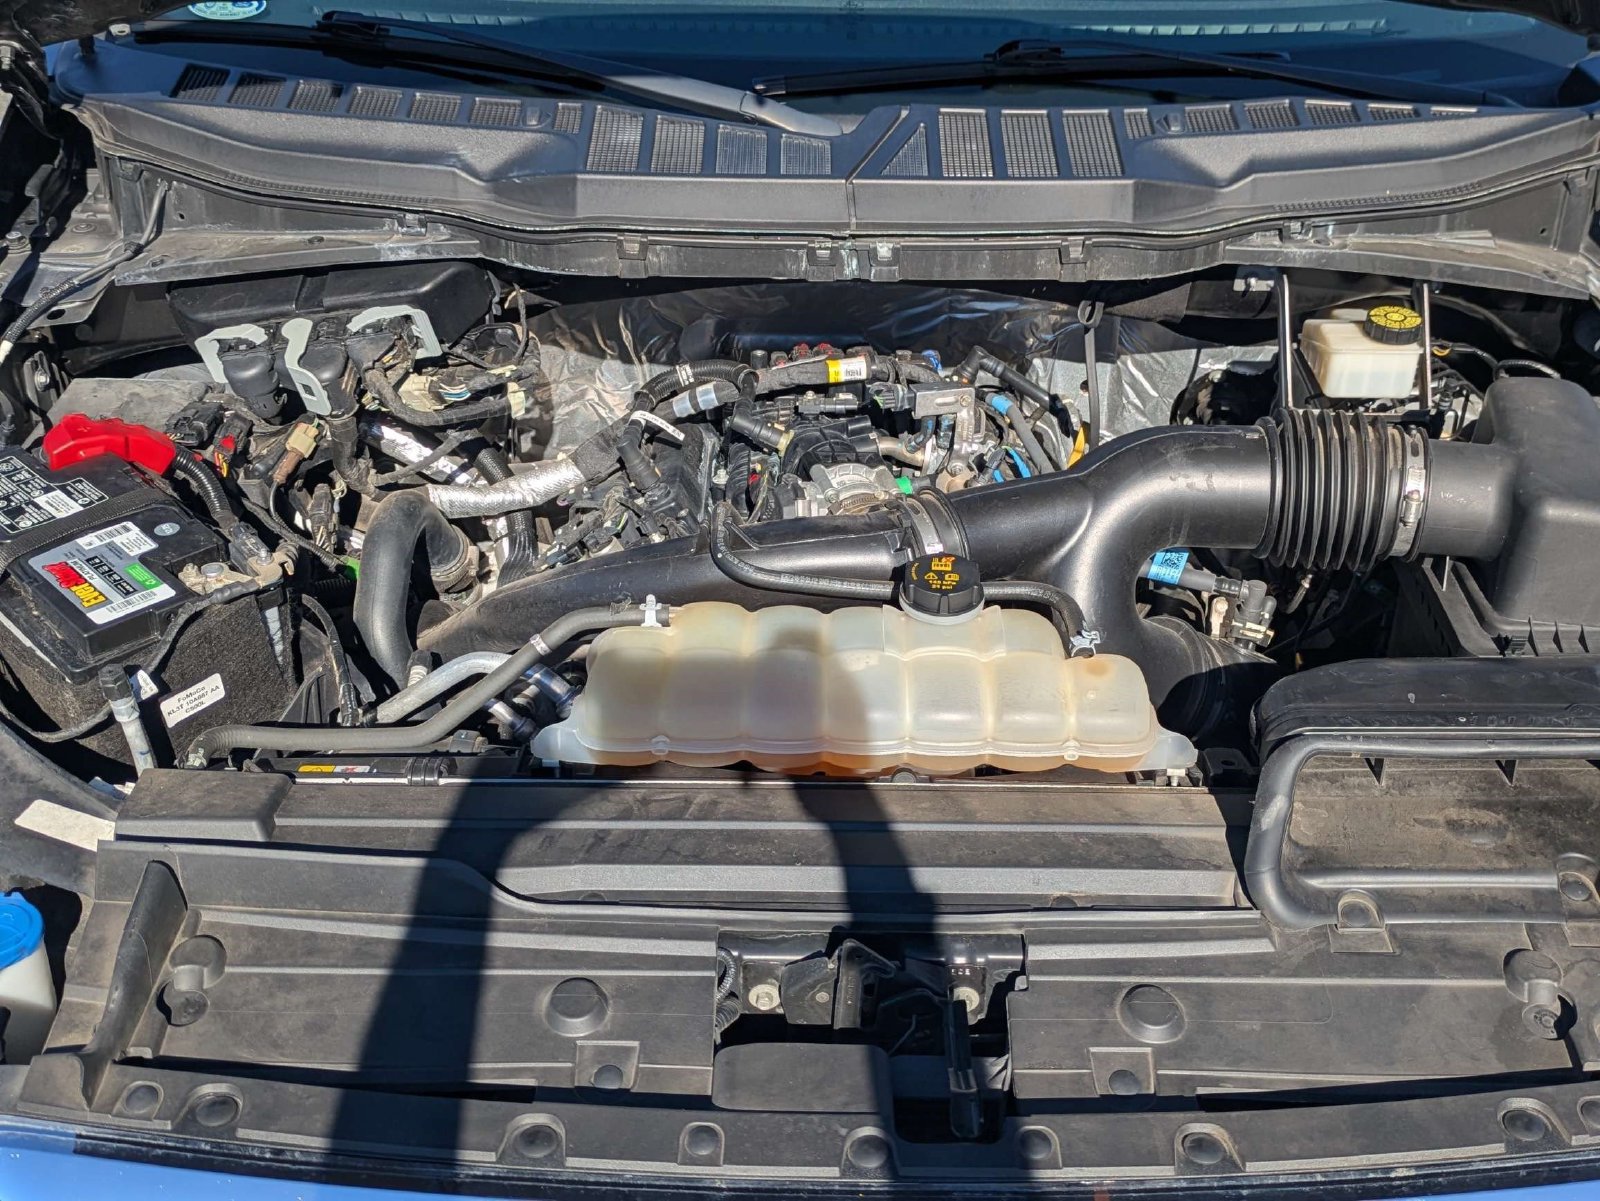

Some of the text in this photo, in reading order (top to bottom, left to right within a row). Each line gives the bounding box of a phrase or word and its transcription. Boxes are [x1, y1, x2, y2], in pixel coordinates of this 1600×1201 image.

[41, 561, 107, 608] EverStart
[167, 704, 184, 717] KL3T
[210, 685, 220, 694] AA
[177, 686, 206, 703] FoMoCo
